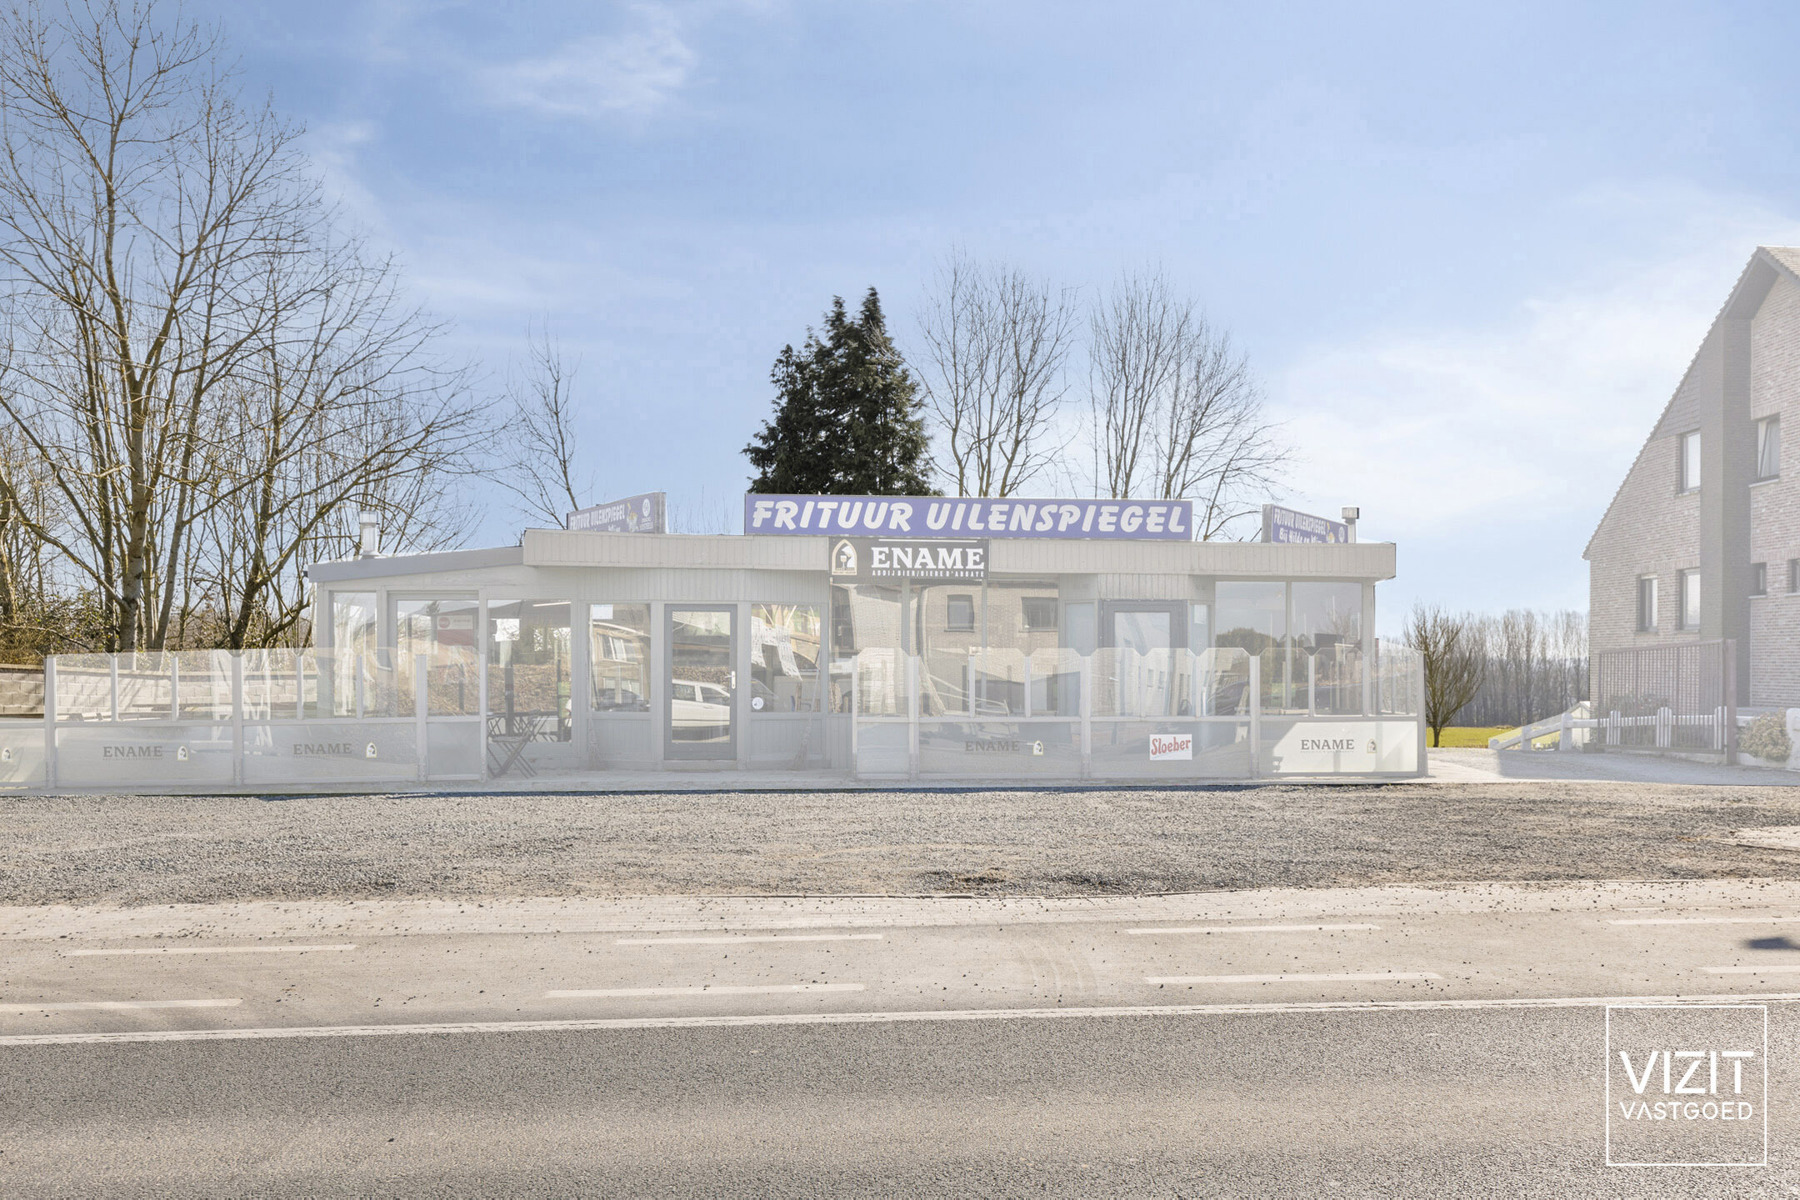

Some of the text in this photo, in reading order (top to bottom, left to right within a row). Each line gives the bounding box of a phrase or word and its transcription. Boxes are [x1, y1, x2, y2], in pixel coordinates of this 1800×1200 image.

[752, 500, 1185, 533] FRITUUR UILENSPIEGEL
[871, 547, 985, 569] ENAME
[292, 743, 352, 755] ENAME
[965, 740, 1021, 752] ENAME
[1151, 736, 1191, 756] Sloeber
[1300, 739, 1355, 750] ENAME
[102, 745, 164, 758] ENAME
